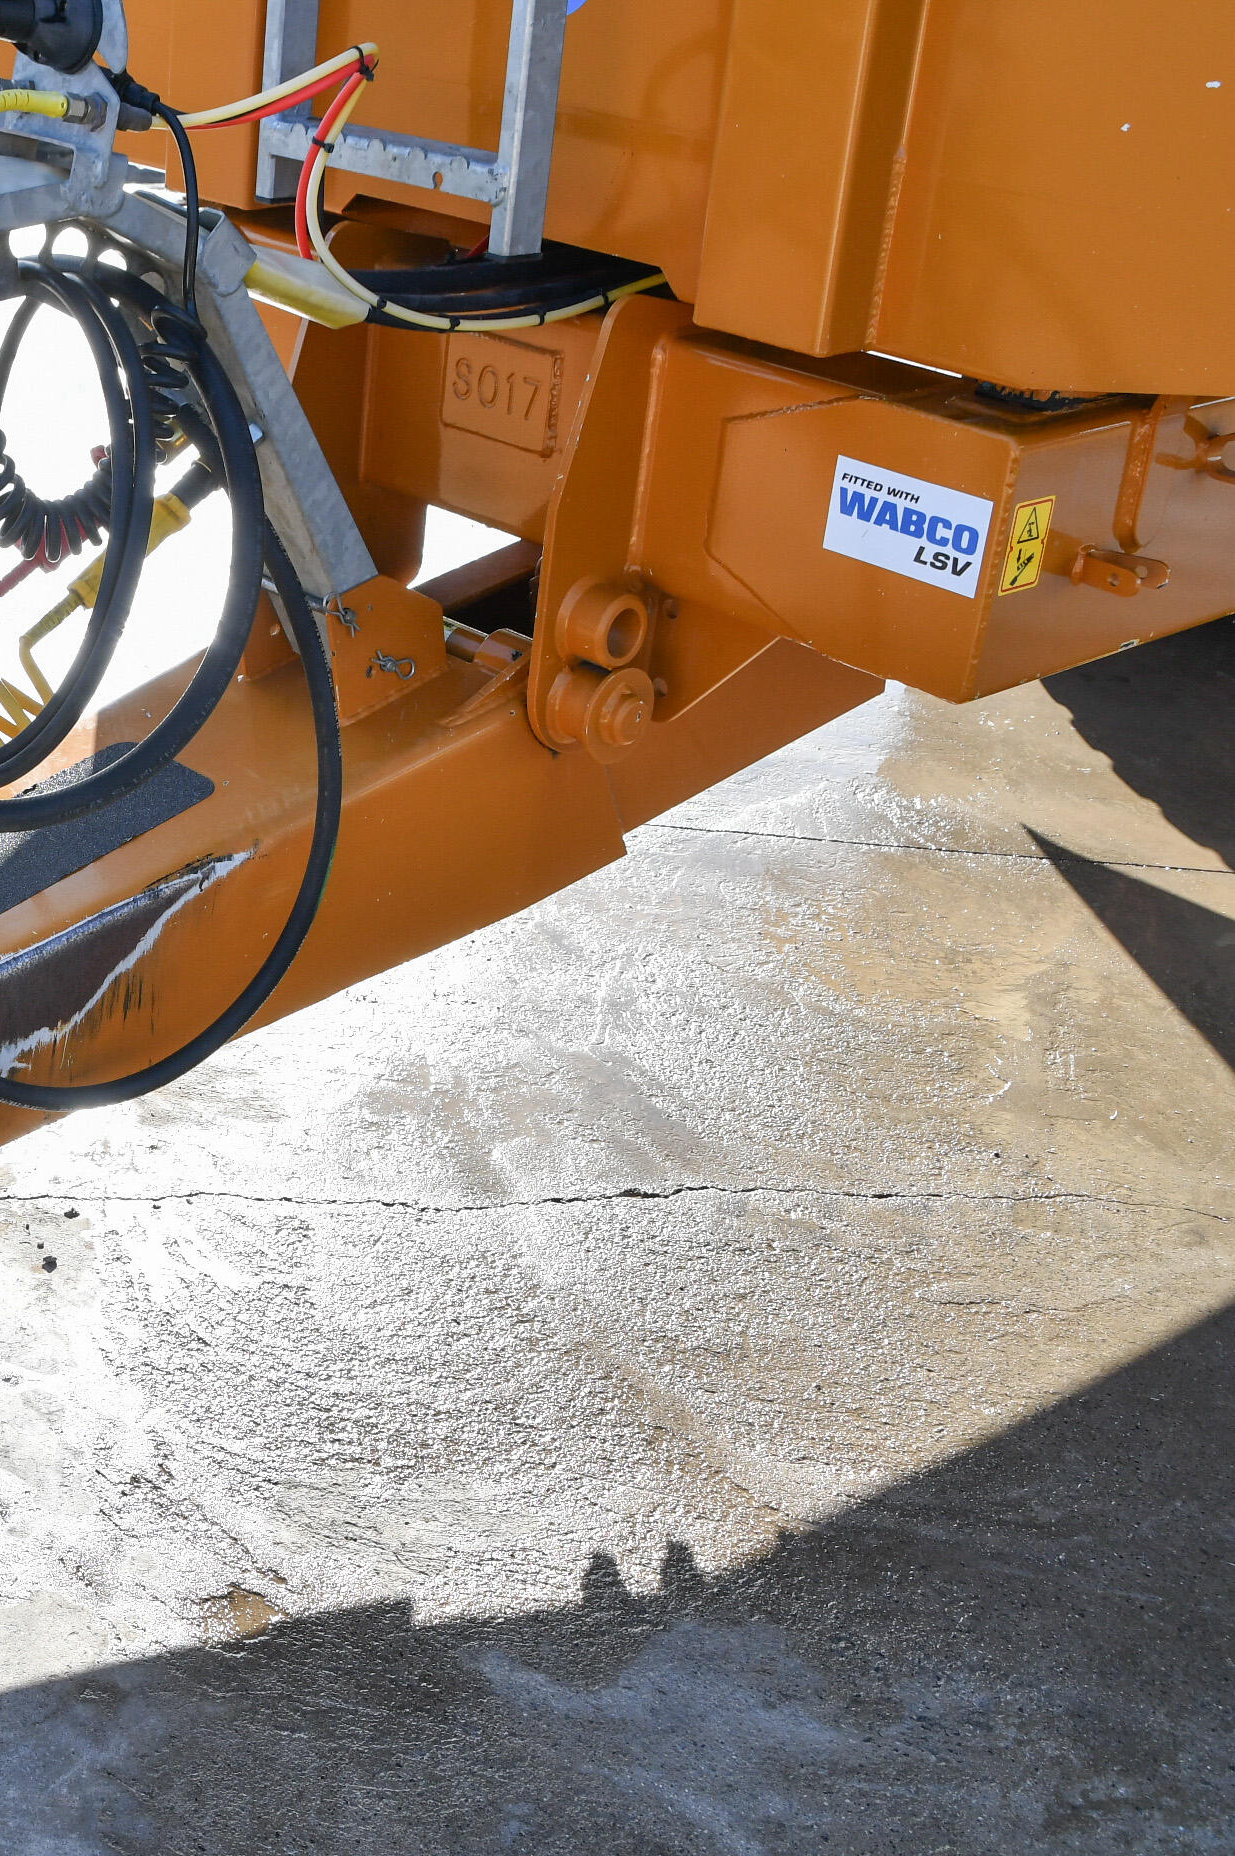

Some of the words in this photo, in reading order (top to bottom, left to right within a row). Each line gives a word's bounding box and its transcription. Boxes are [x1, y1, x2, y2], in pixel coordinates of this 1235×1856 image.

[841, 472, 883, 492] FITTED
[887, 486, 920, 504] WITH
[839, 486, 979, 556] WABCO
[913, 546, 972, 577] LSV
